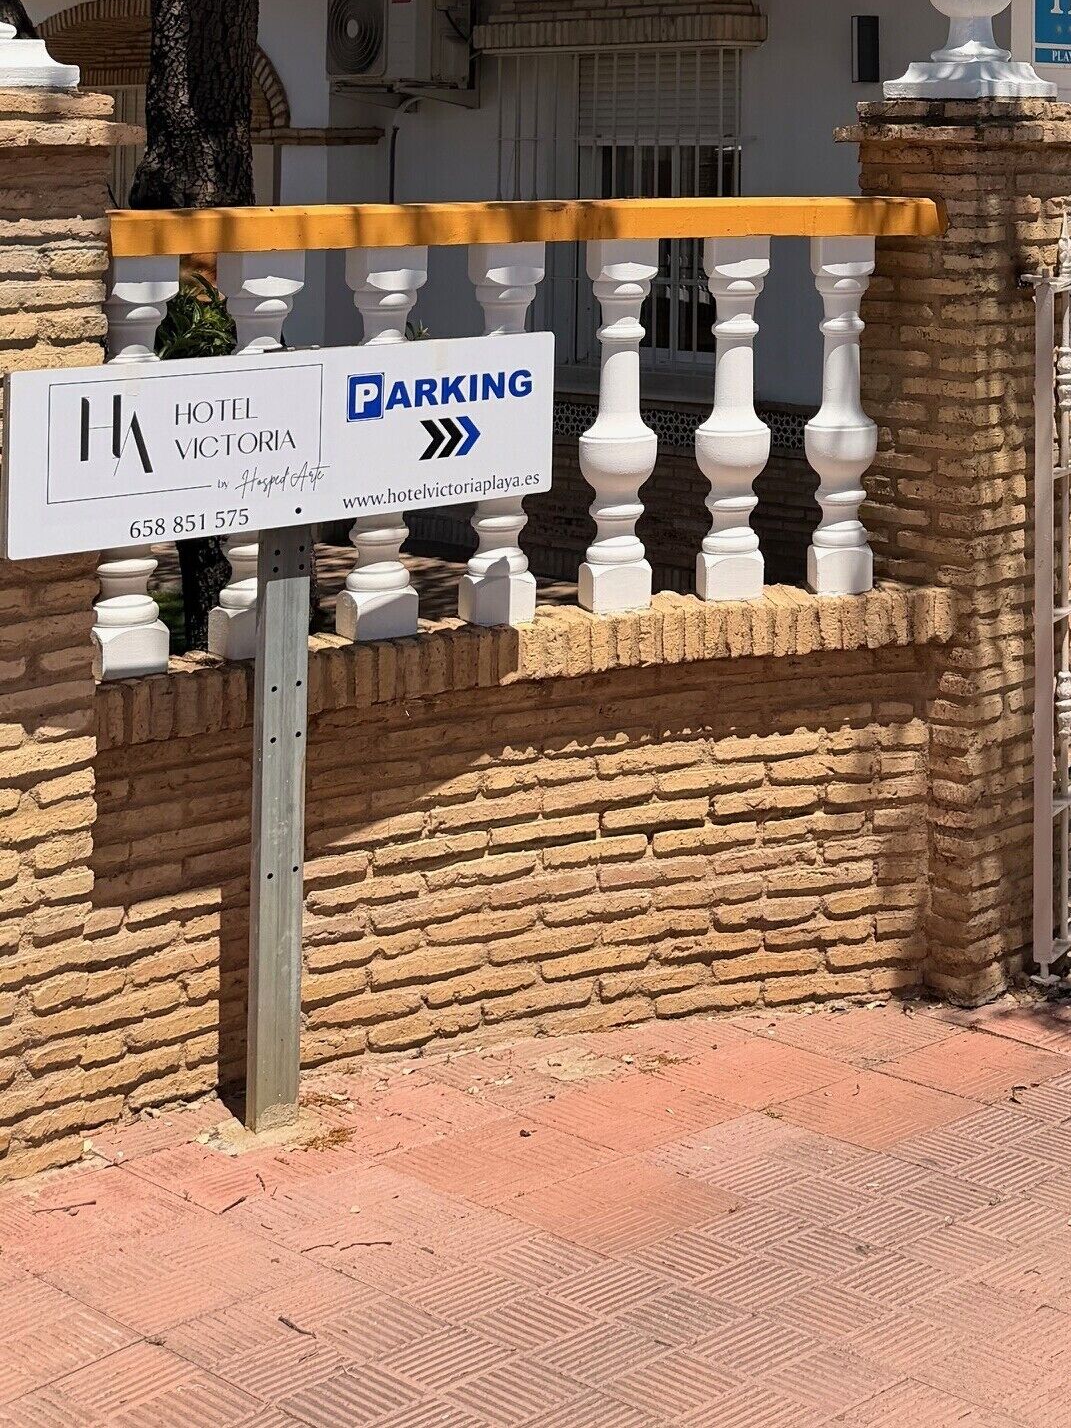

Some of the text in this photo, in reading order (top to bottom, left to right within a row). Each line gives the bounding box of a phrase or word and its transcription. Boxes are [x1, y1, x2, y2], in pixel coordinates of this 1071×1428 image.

[352, 369, 532, 415] PARKING
[175, 397, 258, 426] HOTEL
[175, 429, 297, 460] VICTORIA
[343, 473, 540, 510] www.hotelvictoriaplaya.es
[129, 508, 249, 539] 658 851 575
